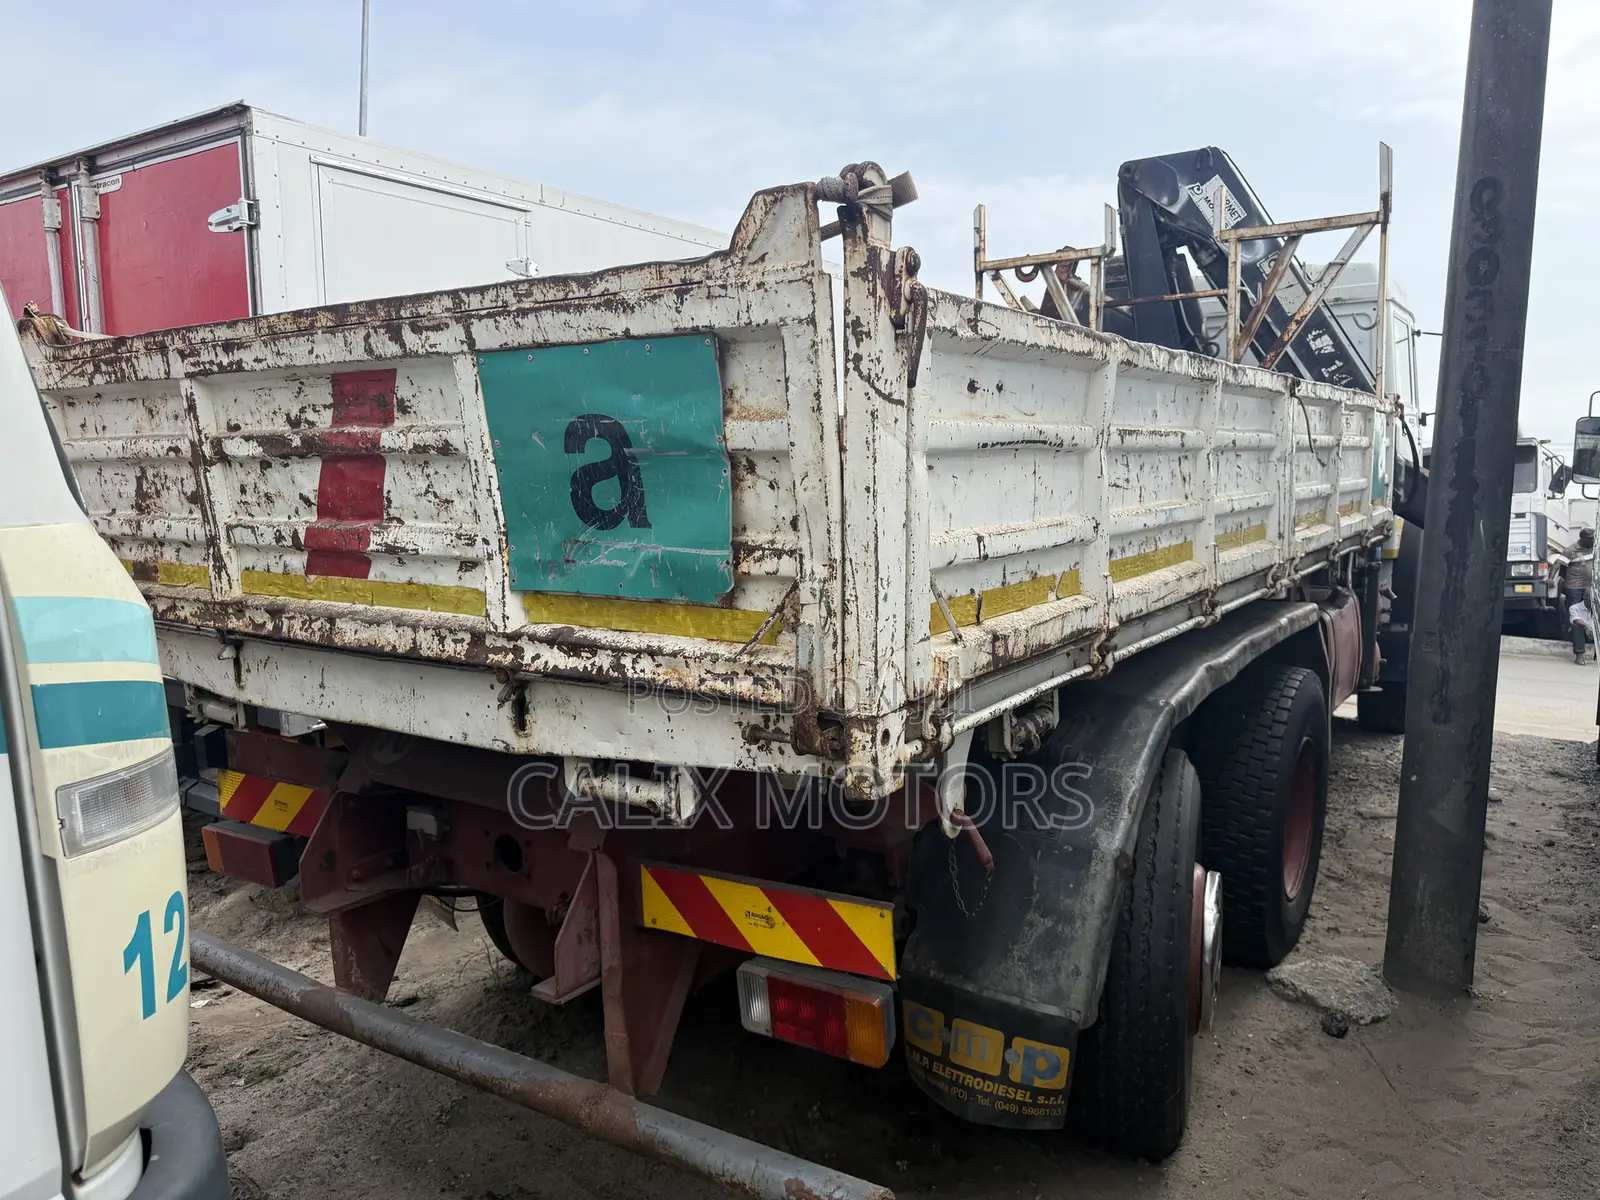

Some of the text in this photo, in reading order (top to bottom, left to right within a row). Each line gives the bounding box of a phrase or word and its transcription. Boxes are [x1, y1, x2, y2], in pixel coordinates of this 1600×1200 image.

[563, 413, 653, 531] a
[123, 890, 188, 1021] 12
[931, 1060, 1033, 1103] ELETTRODIESEL
[1036, 1094, 1065, 1105] s.r.l.
[950, 1085, 968, 1102] (PD)
[976, 1094, 992, 1107] Tel.
[994, 1100, 1019, 1114] (049)
